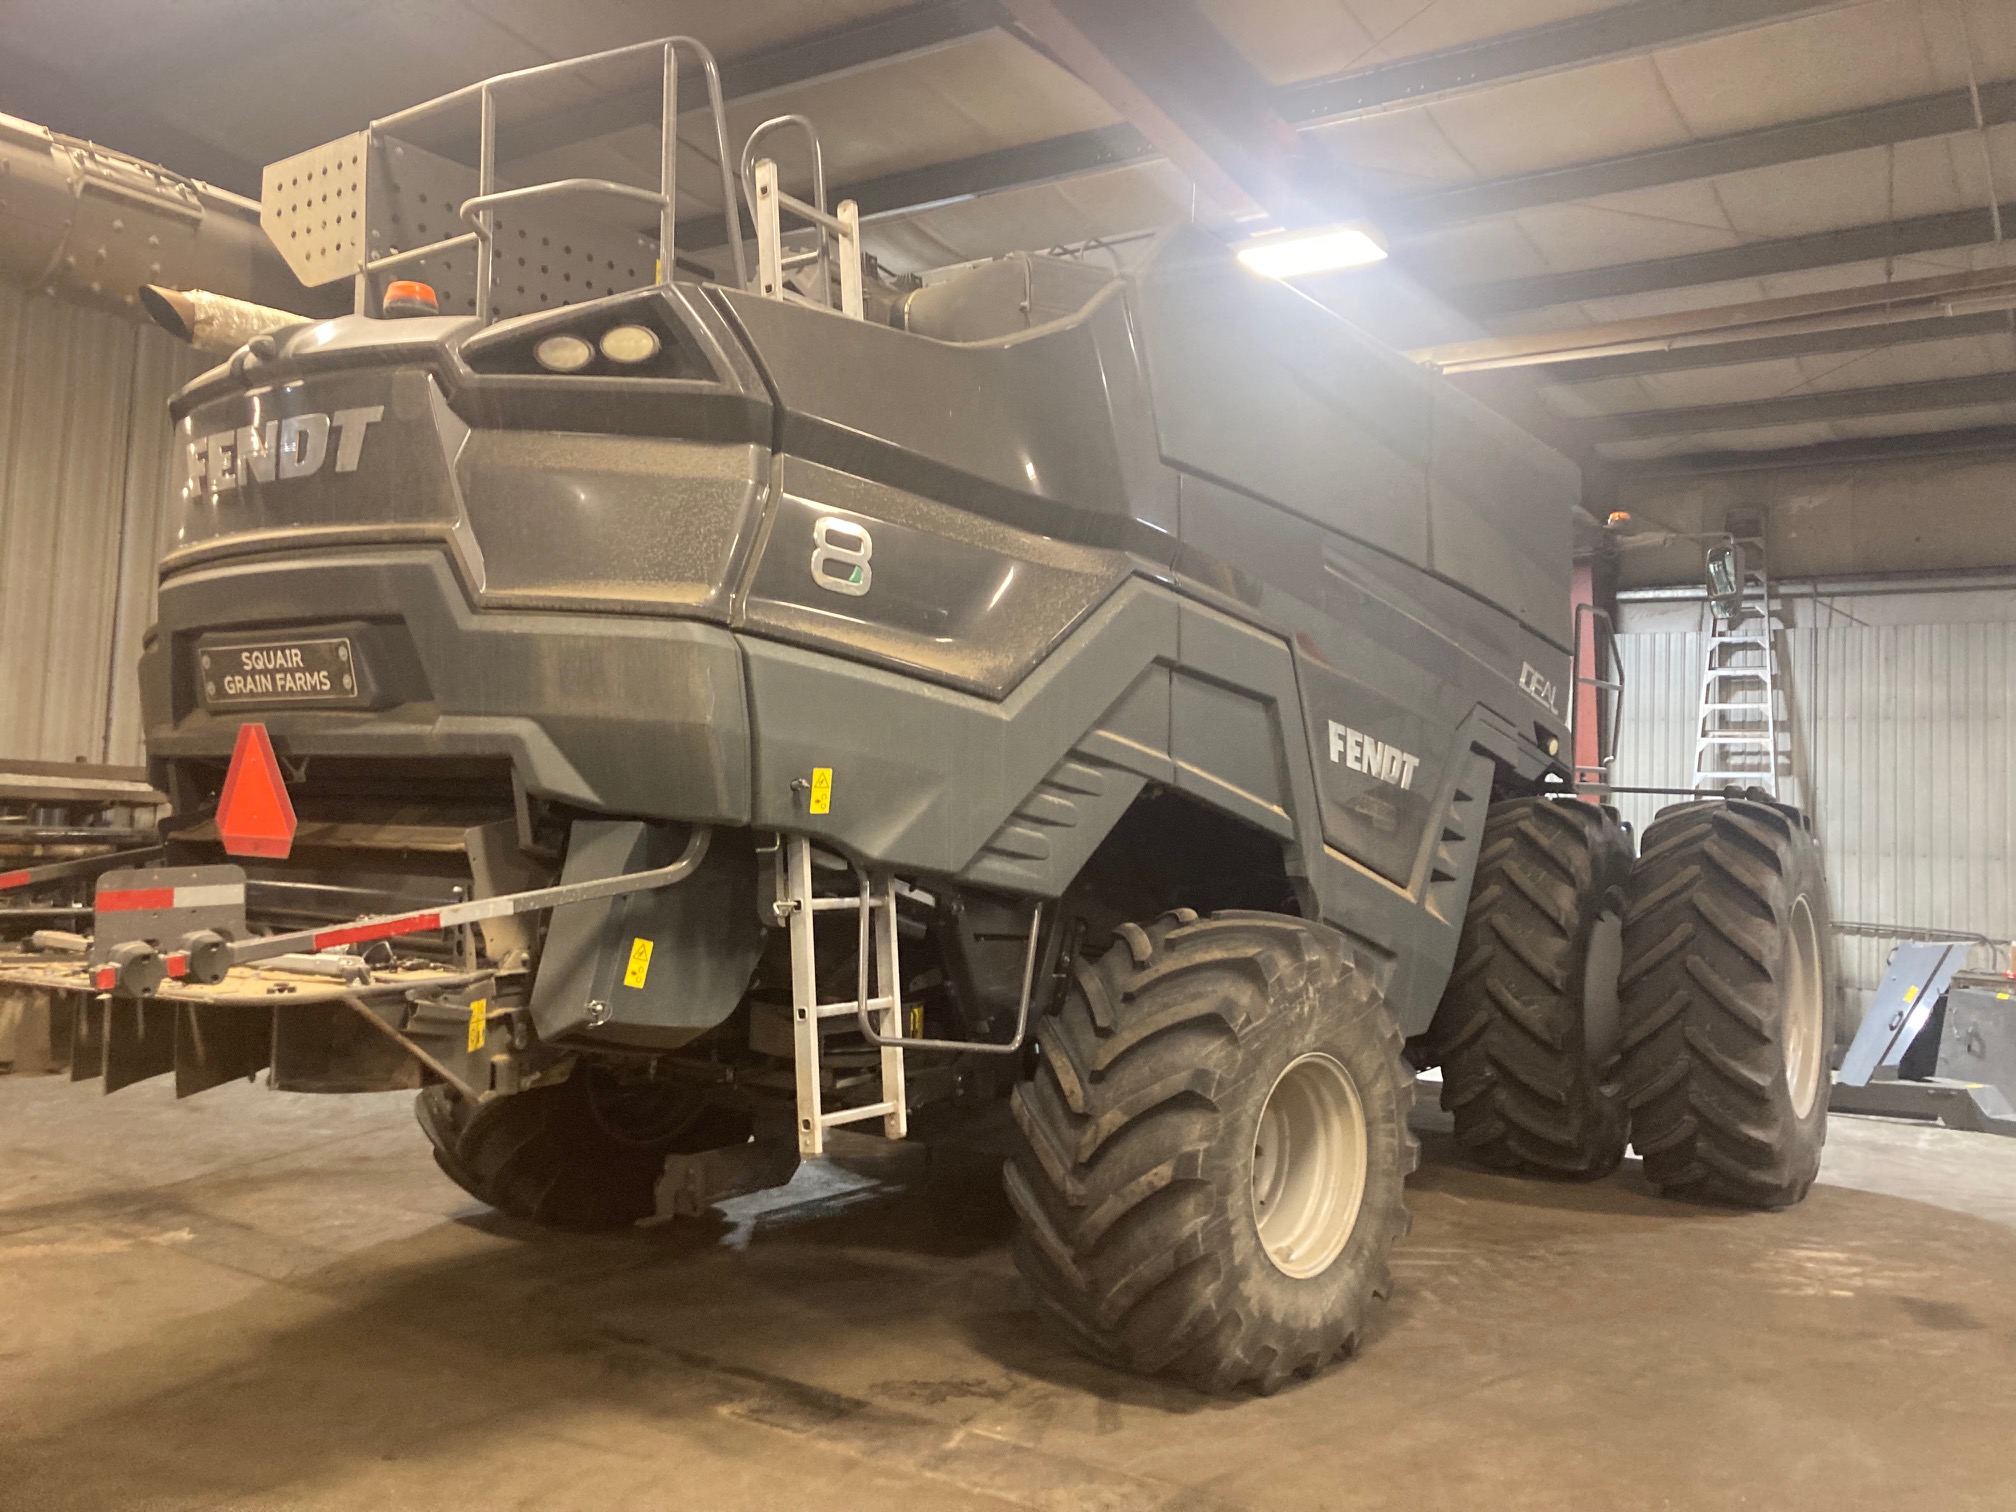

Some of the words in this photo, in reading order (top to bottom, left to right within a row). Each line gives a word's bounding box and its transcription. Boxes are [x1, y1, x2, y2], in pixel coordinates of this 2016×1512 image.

[186, 405, 385, 498] FENDT
[811, 516, 873, 596] 8
[224, 674, 273, 694] GRAIN
[275, 670, 331, 692] FARMS
[241, 648, 304, 670] SQUAIR
[1328, 719, 1420, 790] FENDT
